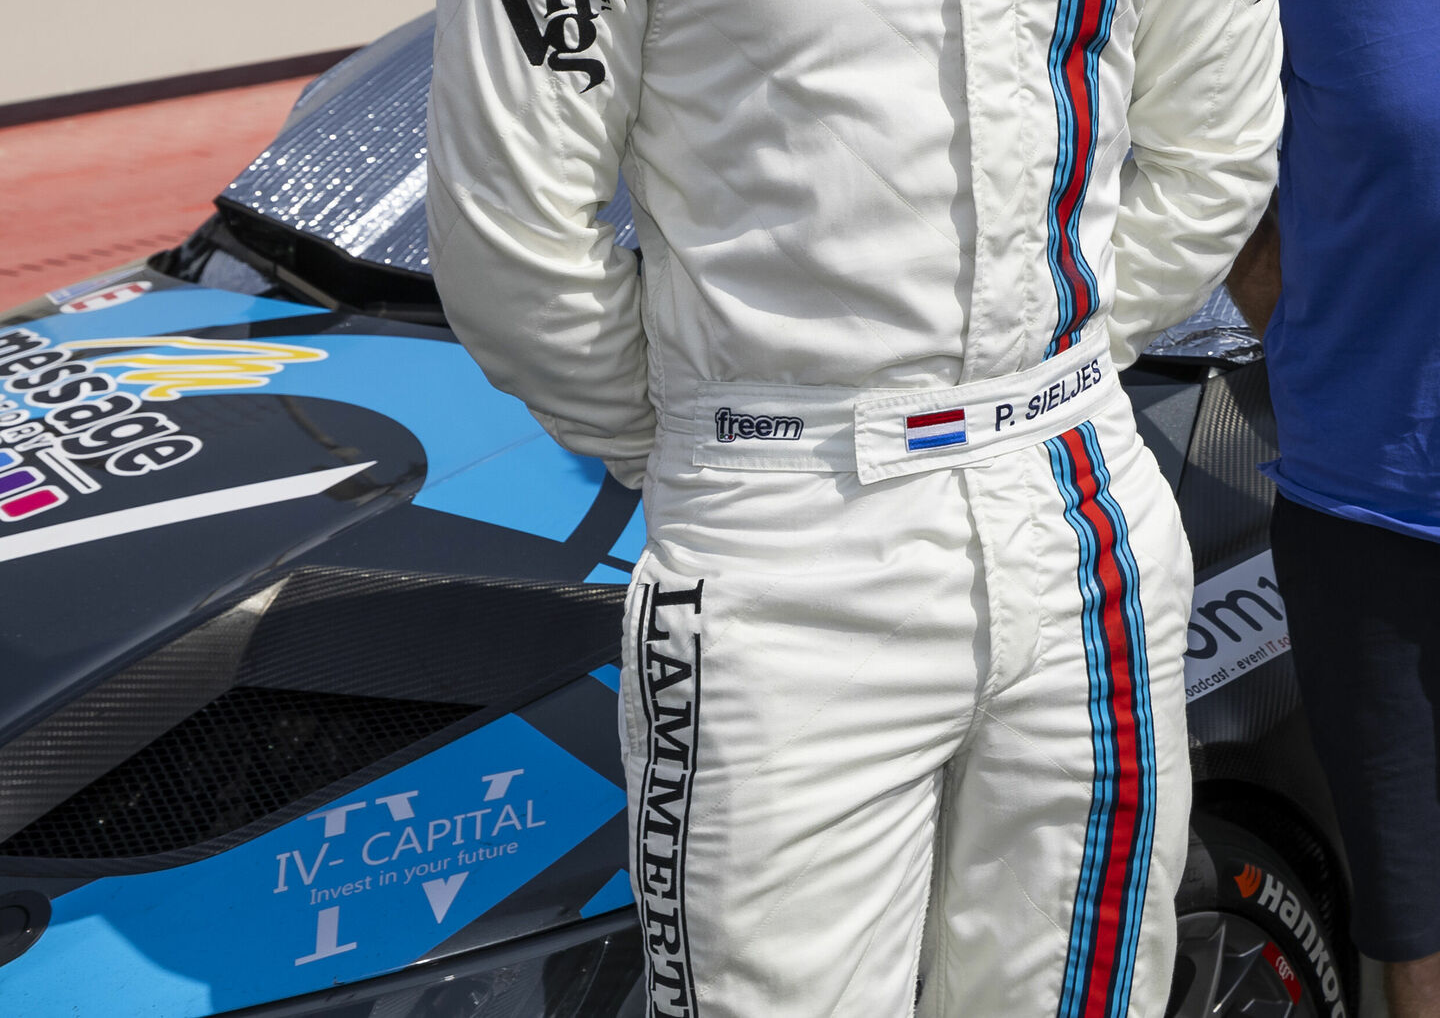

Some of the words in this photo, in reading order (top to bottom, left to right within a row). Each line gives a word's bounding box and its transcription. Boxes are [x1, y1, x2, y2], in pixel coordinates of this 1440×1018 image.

[717, 411, 803, 441] freem
[995, 403, 1016, 431] P.
[1025, 358, 1102, 419] SIELJES
[1237, 647, 1268, 671] event
[361, 799, 547, 867] CAPITAL
[308, 875, 373, 906] Invest
[378, 870, 398, 885] in
[402, 856, 452, 885] your
[457, 840, 519, 868] future
